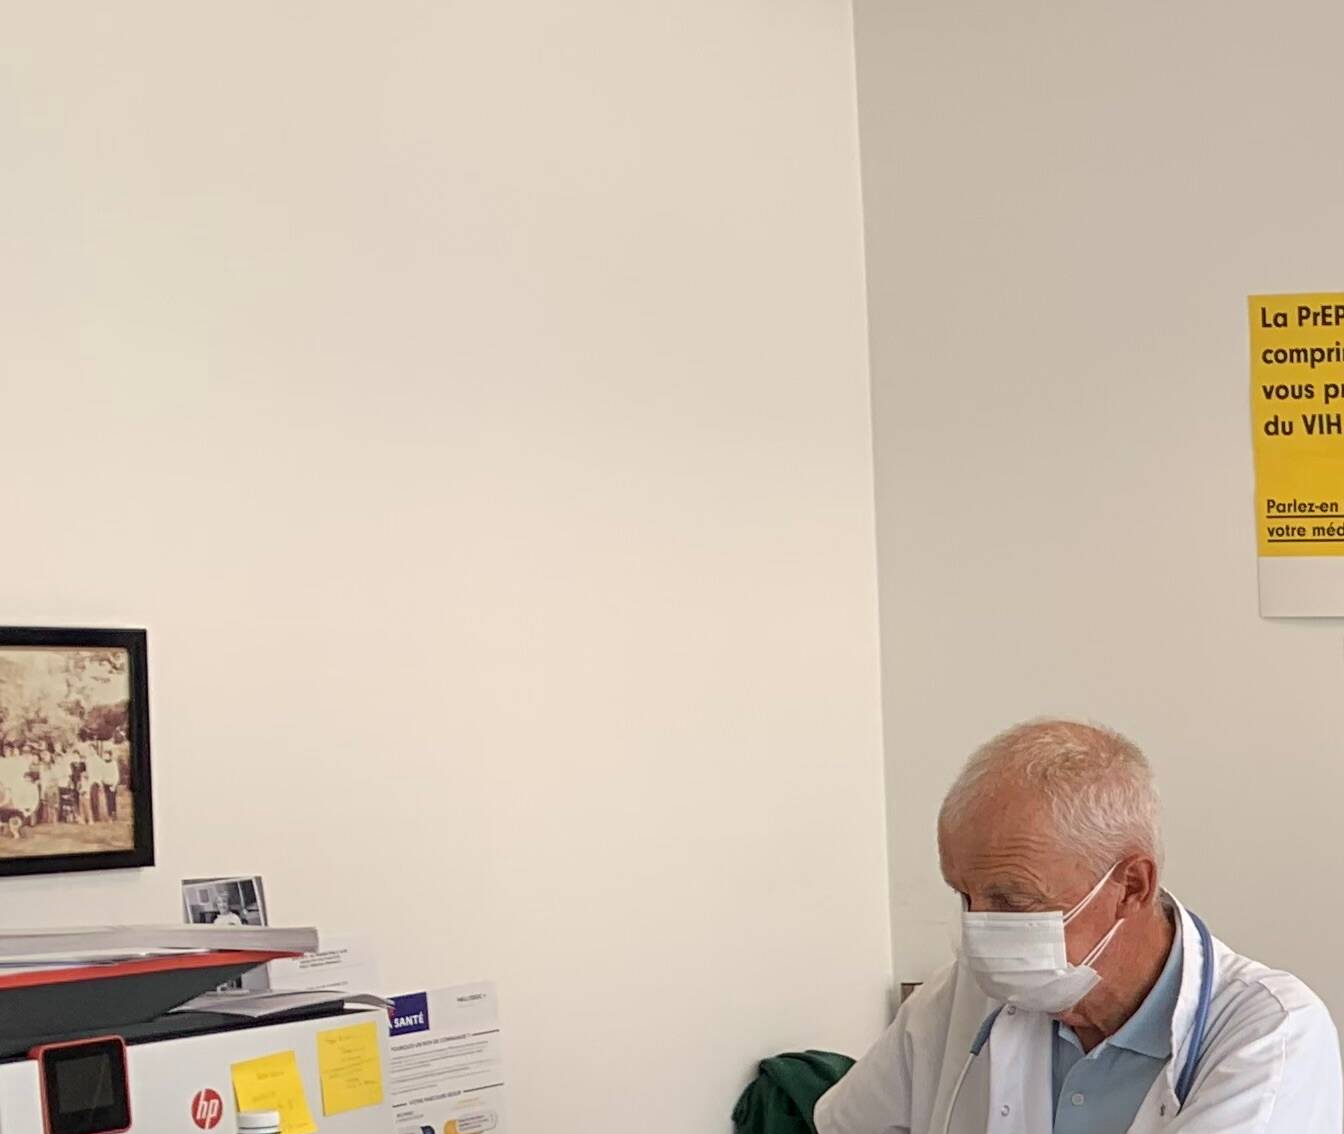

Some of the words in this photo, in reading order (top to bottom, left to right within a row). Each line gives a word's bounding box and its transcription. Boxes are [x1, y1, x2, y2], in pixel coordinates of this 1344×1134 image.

[1261, 307, 1288, 328] La
[1262, 383, 1314, 400] vous
[1264, 415, 1294, 436] du
[1267, 499, 1338, 513] Parlez-en
[1267, 524, 1306, 538] votre
[394, 1011, 425, 1028] SANTÉ
[195, 1088, 220, 1130] hp
